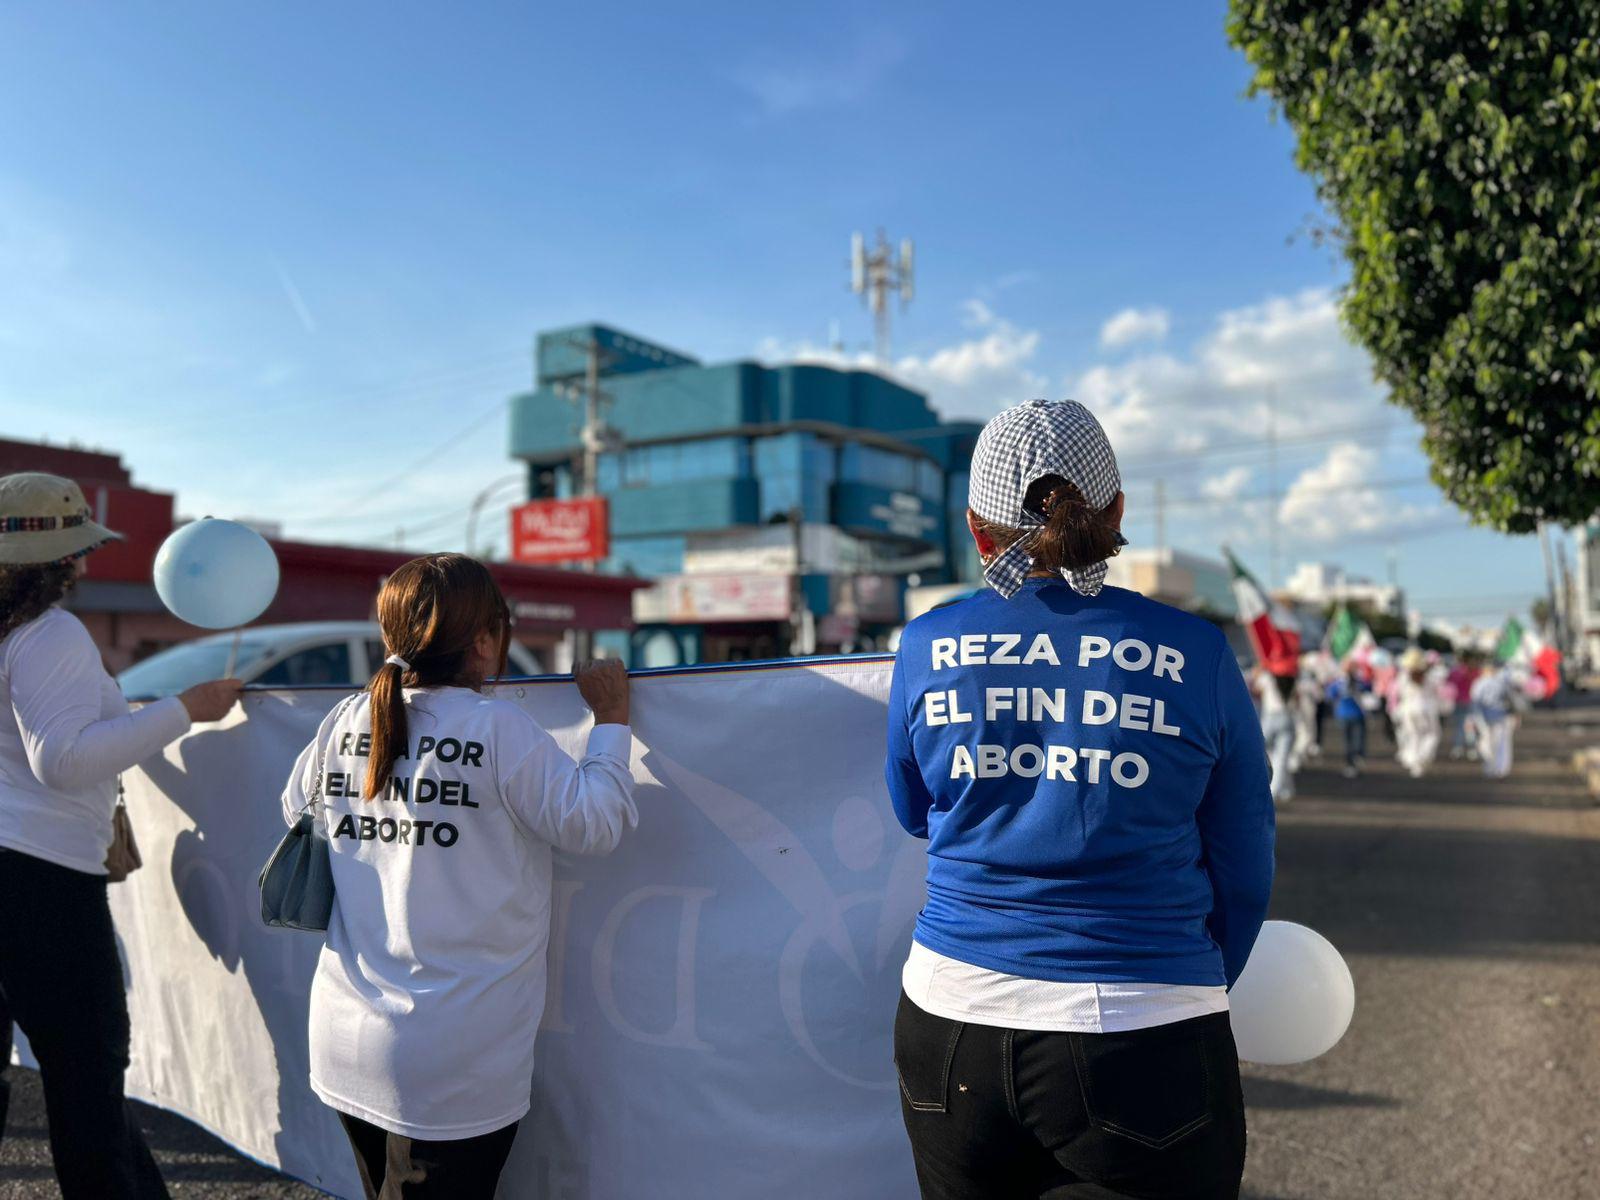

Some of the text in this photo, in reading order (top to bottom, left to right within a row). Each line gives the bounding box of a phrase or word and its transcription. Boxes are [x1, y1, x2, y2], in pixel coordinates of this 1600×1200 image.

[931, 633, 1186, 684] REZA POR
[924, 687, 1182, 737] EL FIN DEL
[416, 736, 484, 767] POR
[950, 743, 1150, 789] ABORTO
[325, 772, 480, 808] EL IN DEL
[333, 814, 459, 848] ABORTO
